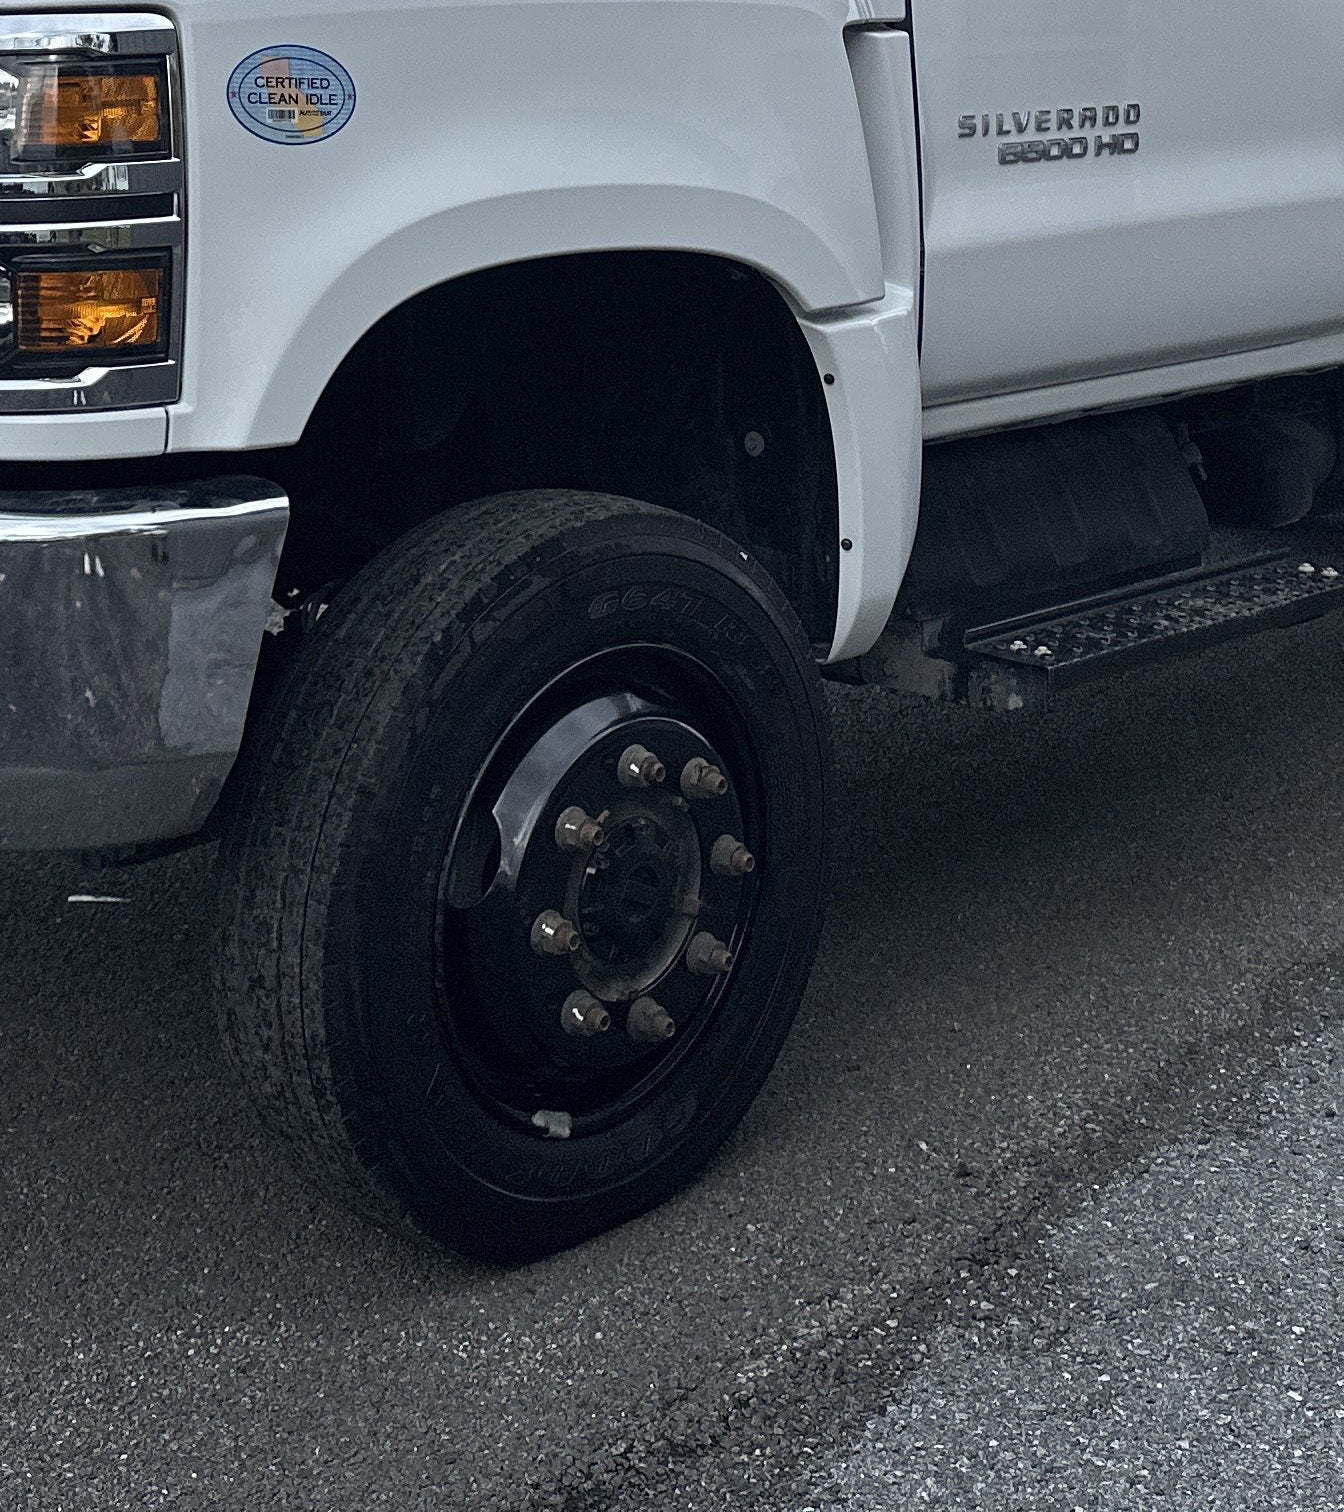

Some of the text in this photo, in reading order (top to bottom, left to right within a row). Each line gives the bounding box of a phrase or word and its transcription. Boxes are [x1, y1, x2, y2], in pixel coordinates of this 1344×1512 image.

[255, 76, 331, 90] CERTIFIED
[247, 92, 338, 106] CLEAN IDLE
[958, 103, 1141, 139] SILVERADO
[1094, 132, 1140, 157] HD
